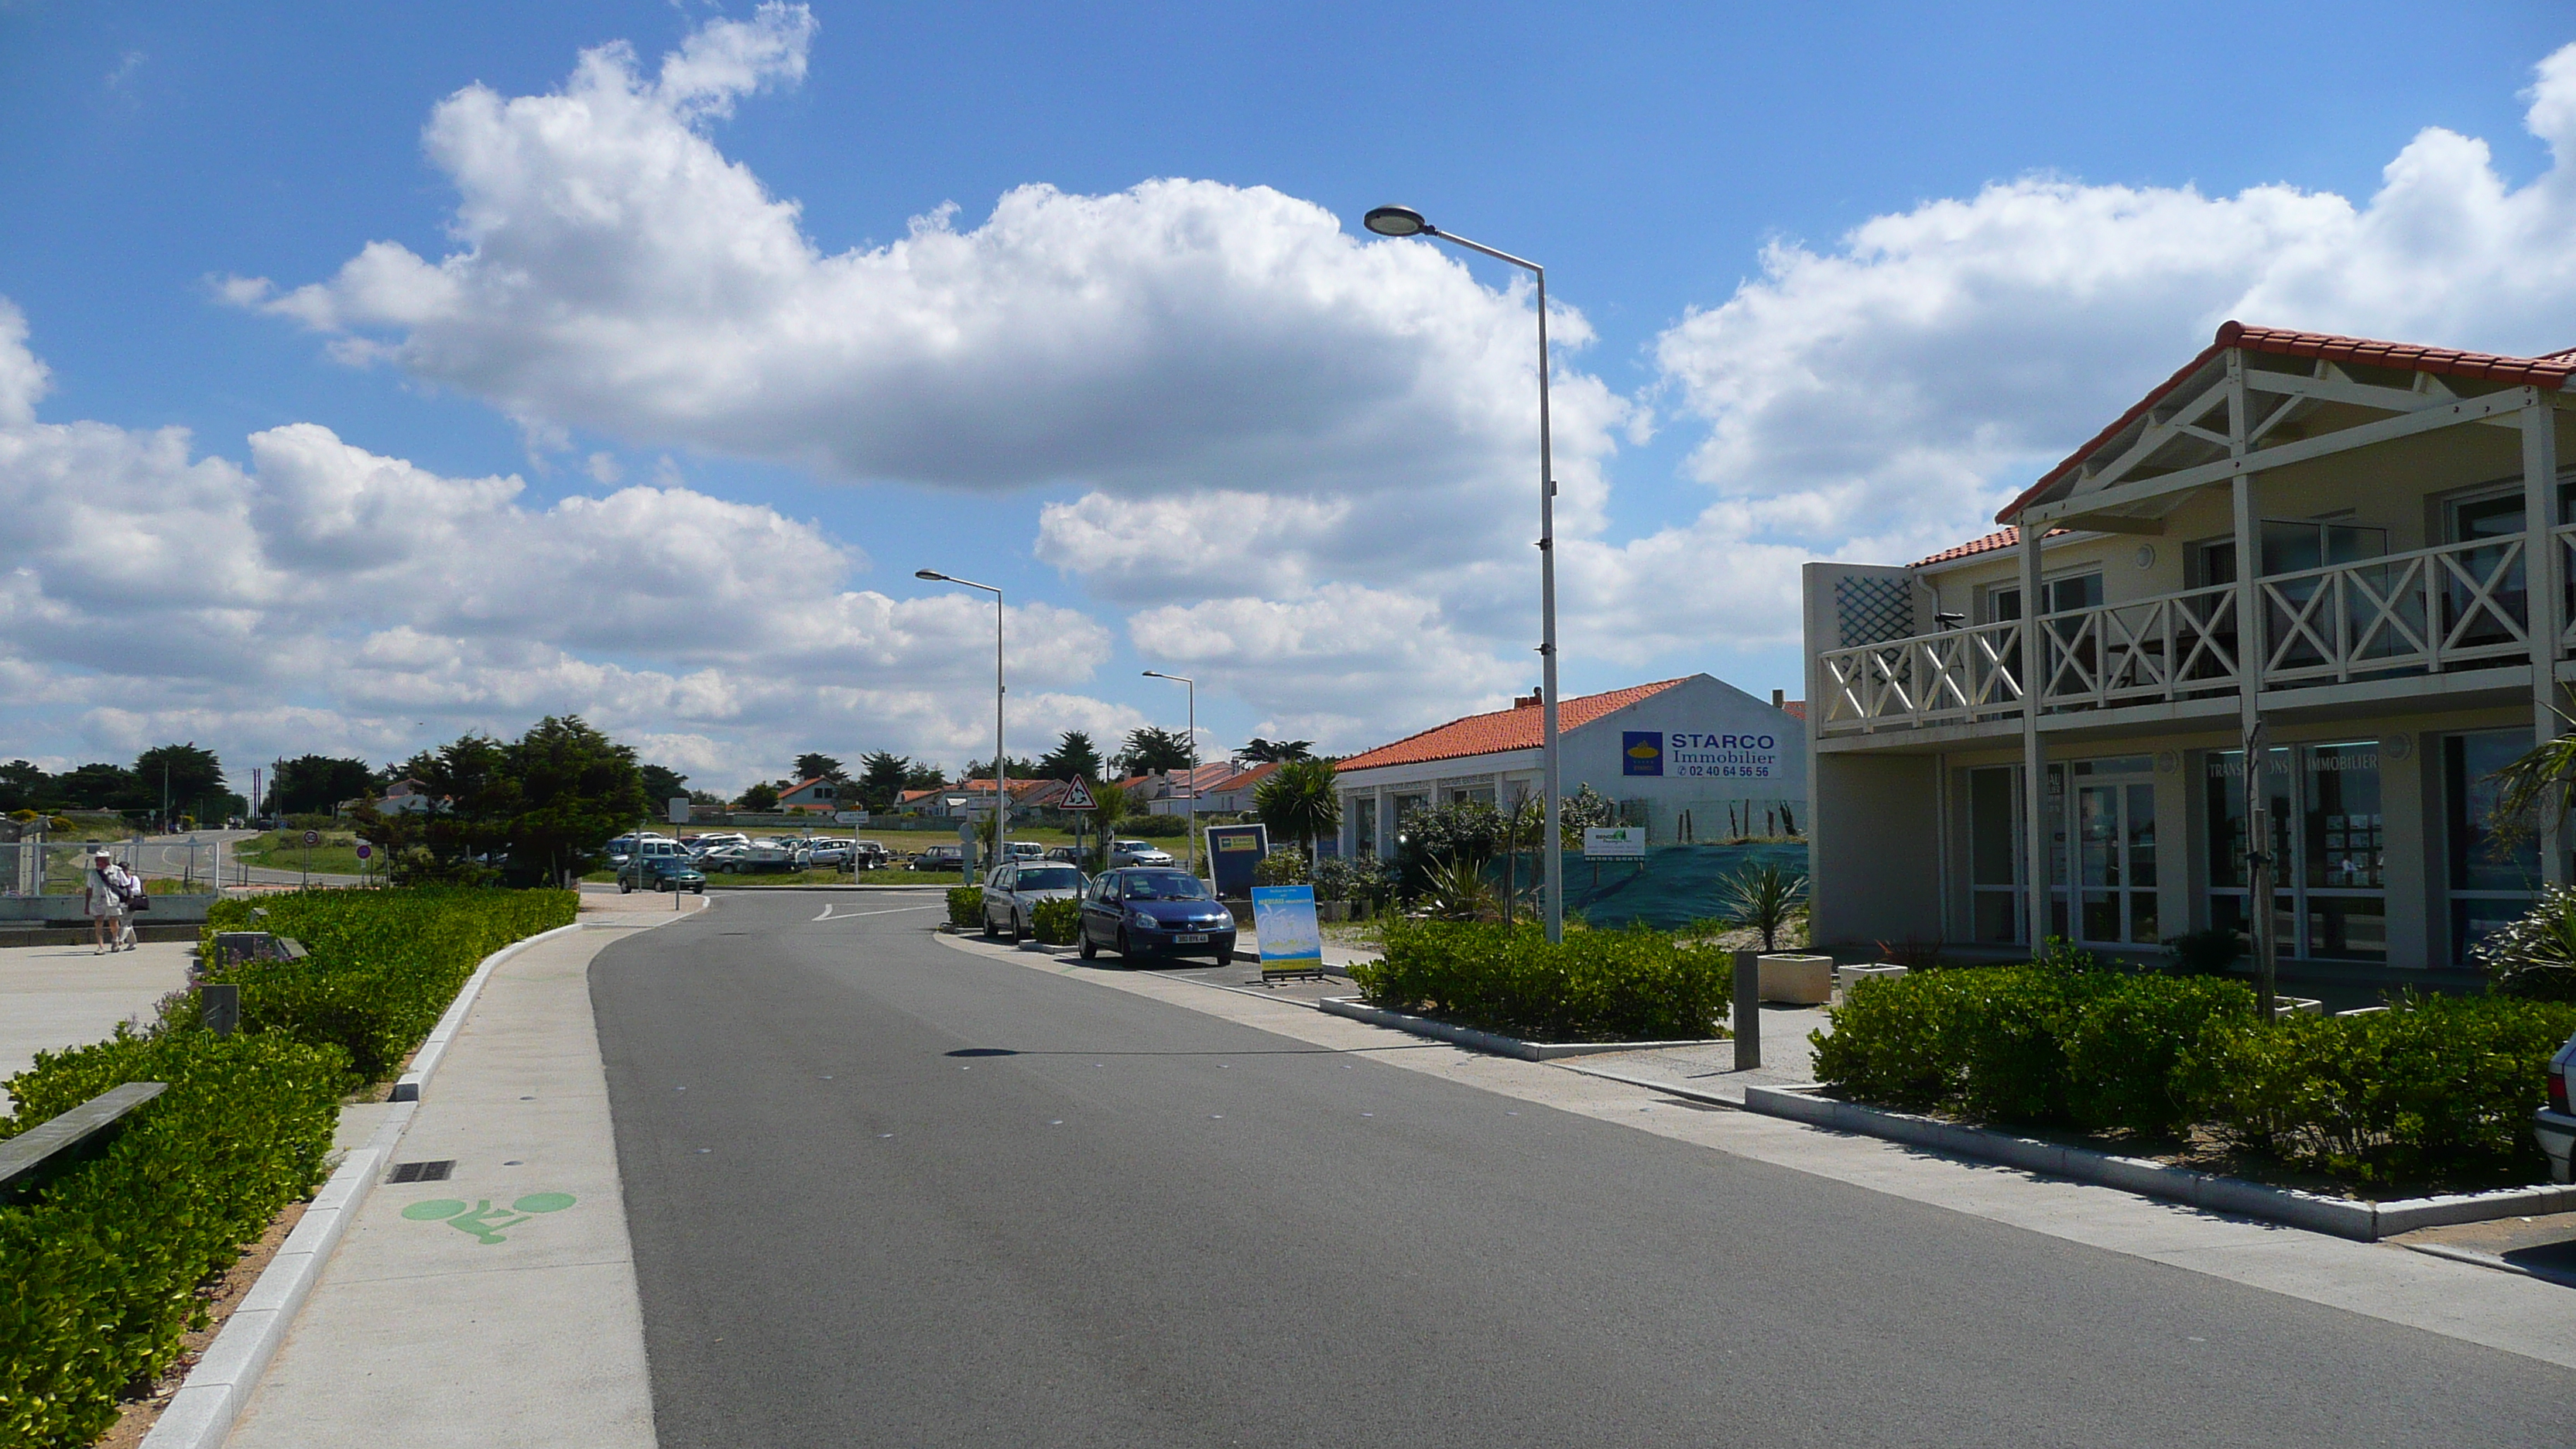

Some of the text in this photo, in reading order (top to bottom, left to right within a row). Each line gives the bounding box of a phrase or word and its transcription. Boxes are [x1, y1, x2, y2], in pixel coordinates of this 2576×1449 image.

[1671, 733, 1775, 749] STARCO
[1673, 750, 1776, 764] Immobilier
[1689, 766, 1769, 776] 02 40 64 56 56
[2209, 754, 2378, 777] TRANSONS IMMOBILIER
